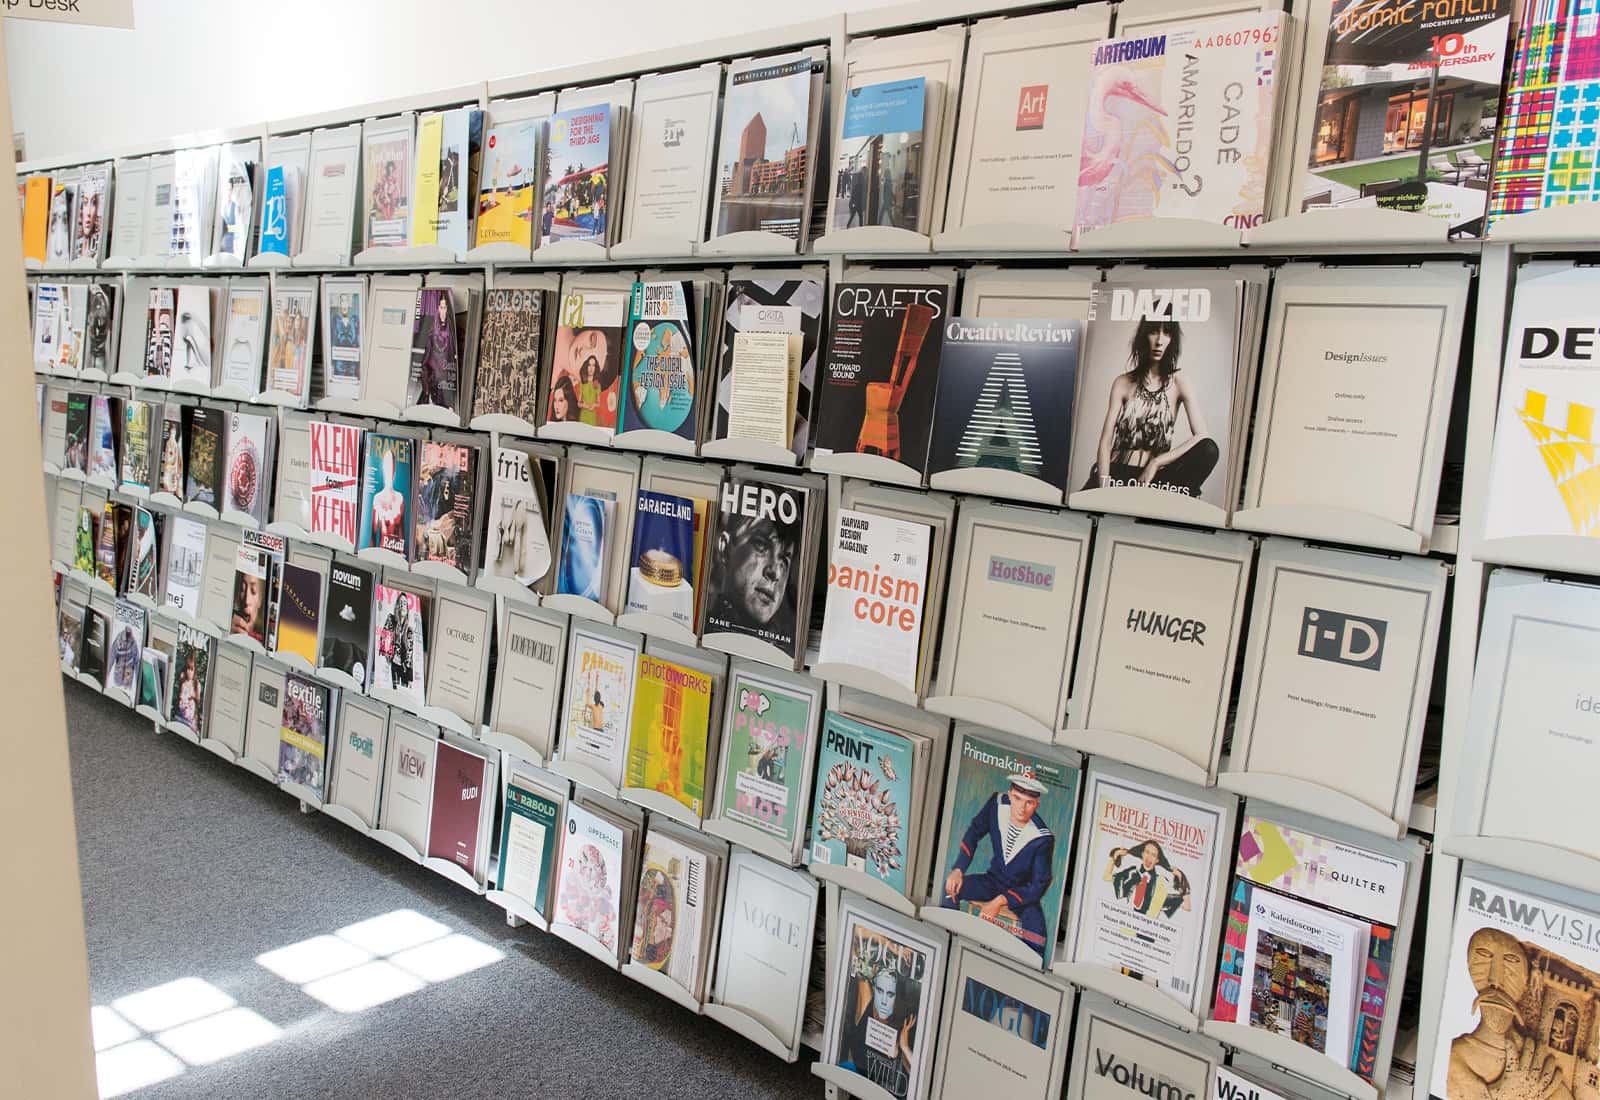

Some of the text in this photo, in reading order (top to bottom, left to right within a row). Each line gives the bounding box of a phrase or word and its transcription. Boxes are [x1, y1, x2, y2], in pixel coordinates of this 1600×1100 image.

[1334, 1, 1415, 35] atomic
[1420, 12, 1496, 28] MIDCENTURY MARVELS
[1094, 35, 1167, 66] ARTFORUM
[1408, 52, 1496, 71] ANNIVERSARY
[734, 67, 779, 81] ARCHITECTURE
[1020, 90, 1046, 115] Art
[570, 112, 604, 127] DESIGNING
[570, 124, 594, 136] FOR THE
[569, 134, 600, 147] THIRD AGE
[487, 290, 541, 312] COLORS
[645, 285, 673, 301] COMPUTER
[837, 287, 943, 319] CRAFTS
[1110, 288, 1212, 322] DAZED
[644, 301, 661, 317] ARTS
[1519, 327, 1600, 361] DE
[829, 362, 861, 372] OUTWARD
[832, 371, 855, 379] BOUND
[640, 372, 686, 390] DESIGN ISSUE
[310, 423, 359, 478] KLEIN
[1100, 475, 1191, 497] The Outsiders
[638, 496, 692, 521] GARAGELAND
[720, 481, 798, 525] HERO
[840, 528, 862, 541] DESIGN
[841, 516, 869, 531] HARVARD
[243, 529, 284, 550] MOVIESCOPE
[838, 539, 869, 555] MAGAZINE
[332, 568, 361, 588] novum
[990, 559, 1053, 587] HotShoe
[853, 596, 916, 632] core
[177, 622, 210, 649] TANK
[446, 626, 476, 645] OCTOBER
[709, 616, 792, 645] DANE DEHAAN
[1126, 608, 1207, 647] HUNGER
[1301, 610, 1380, 662] i-D
[287, 679, 322, 709] textile
[735, 713, 807, 750] PUSSY
[826, 729, 874, 765] PRINT
[963, 741, 1032, 776] Printmaking
[400, 748, 426, 779] view
[1104, 801, 1149, 831] PURPLE
[1153, 815, 1207, 847] FASHION
[588, 826, 619, 849] UPPERCASE
[1304, 862, 1385, 894] THE QUILTER
[743, 900, 801, 950] VOGUE
[1270, 909, 1322, 935] Kaleidoscope
